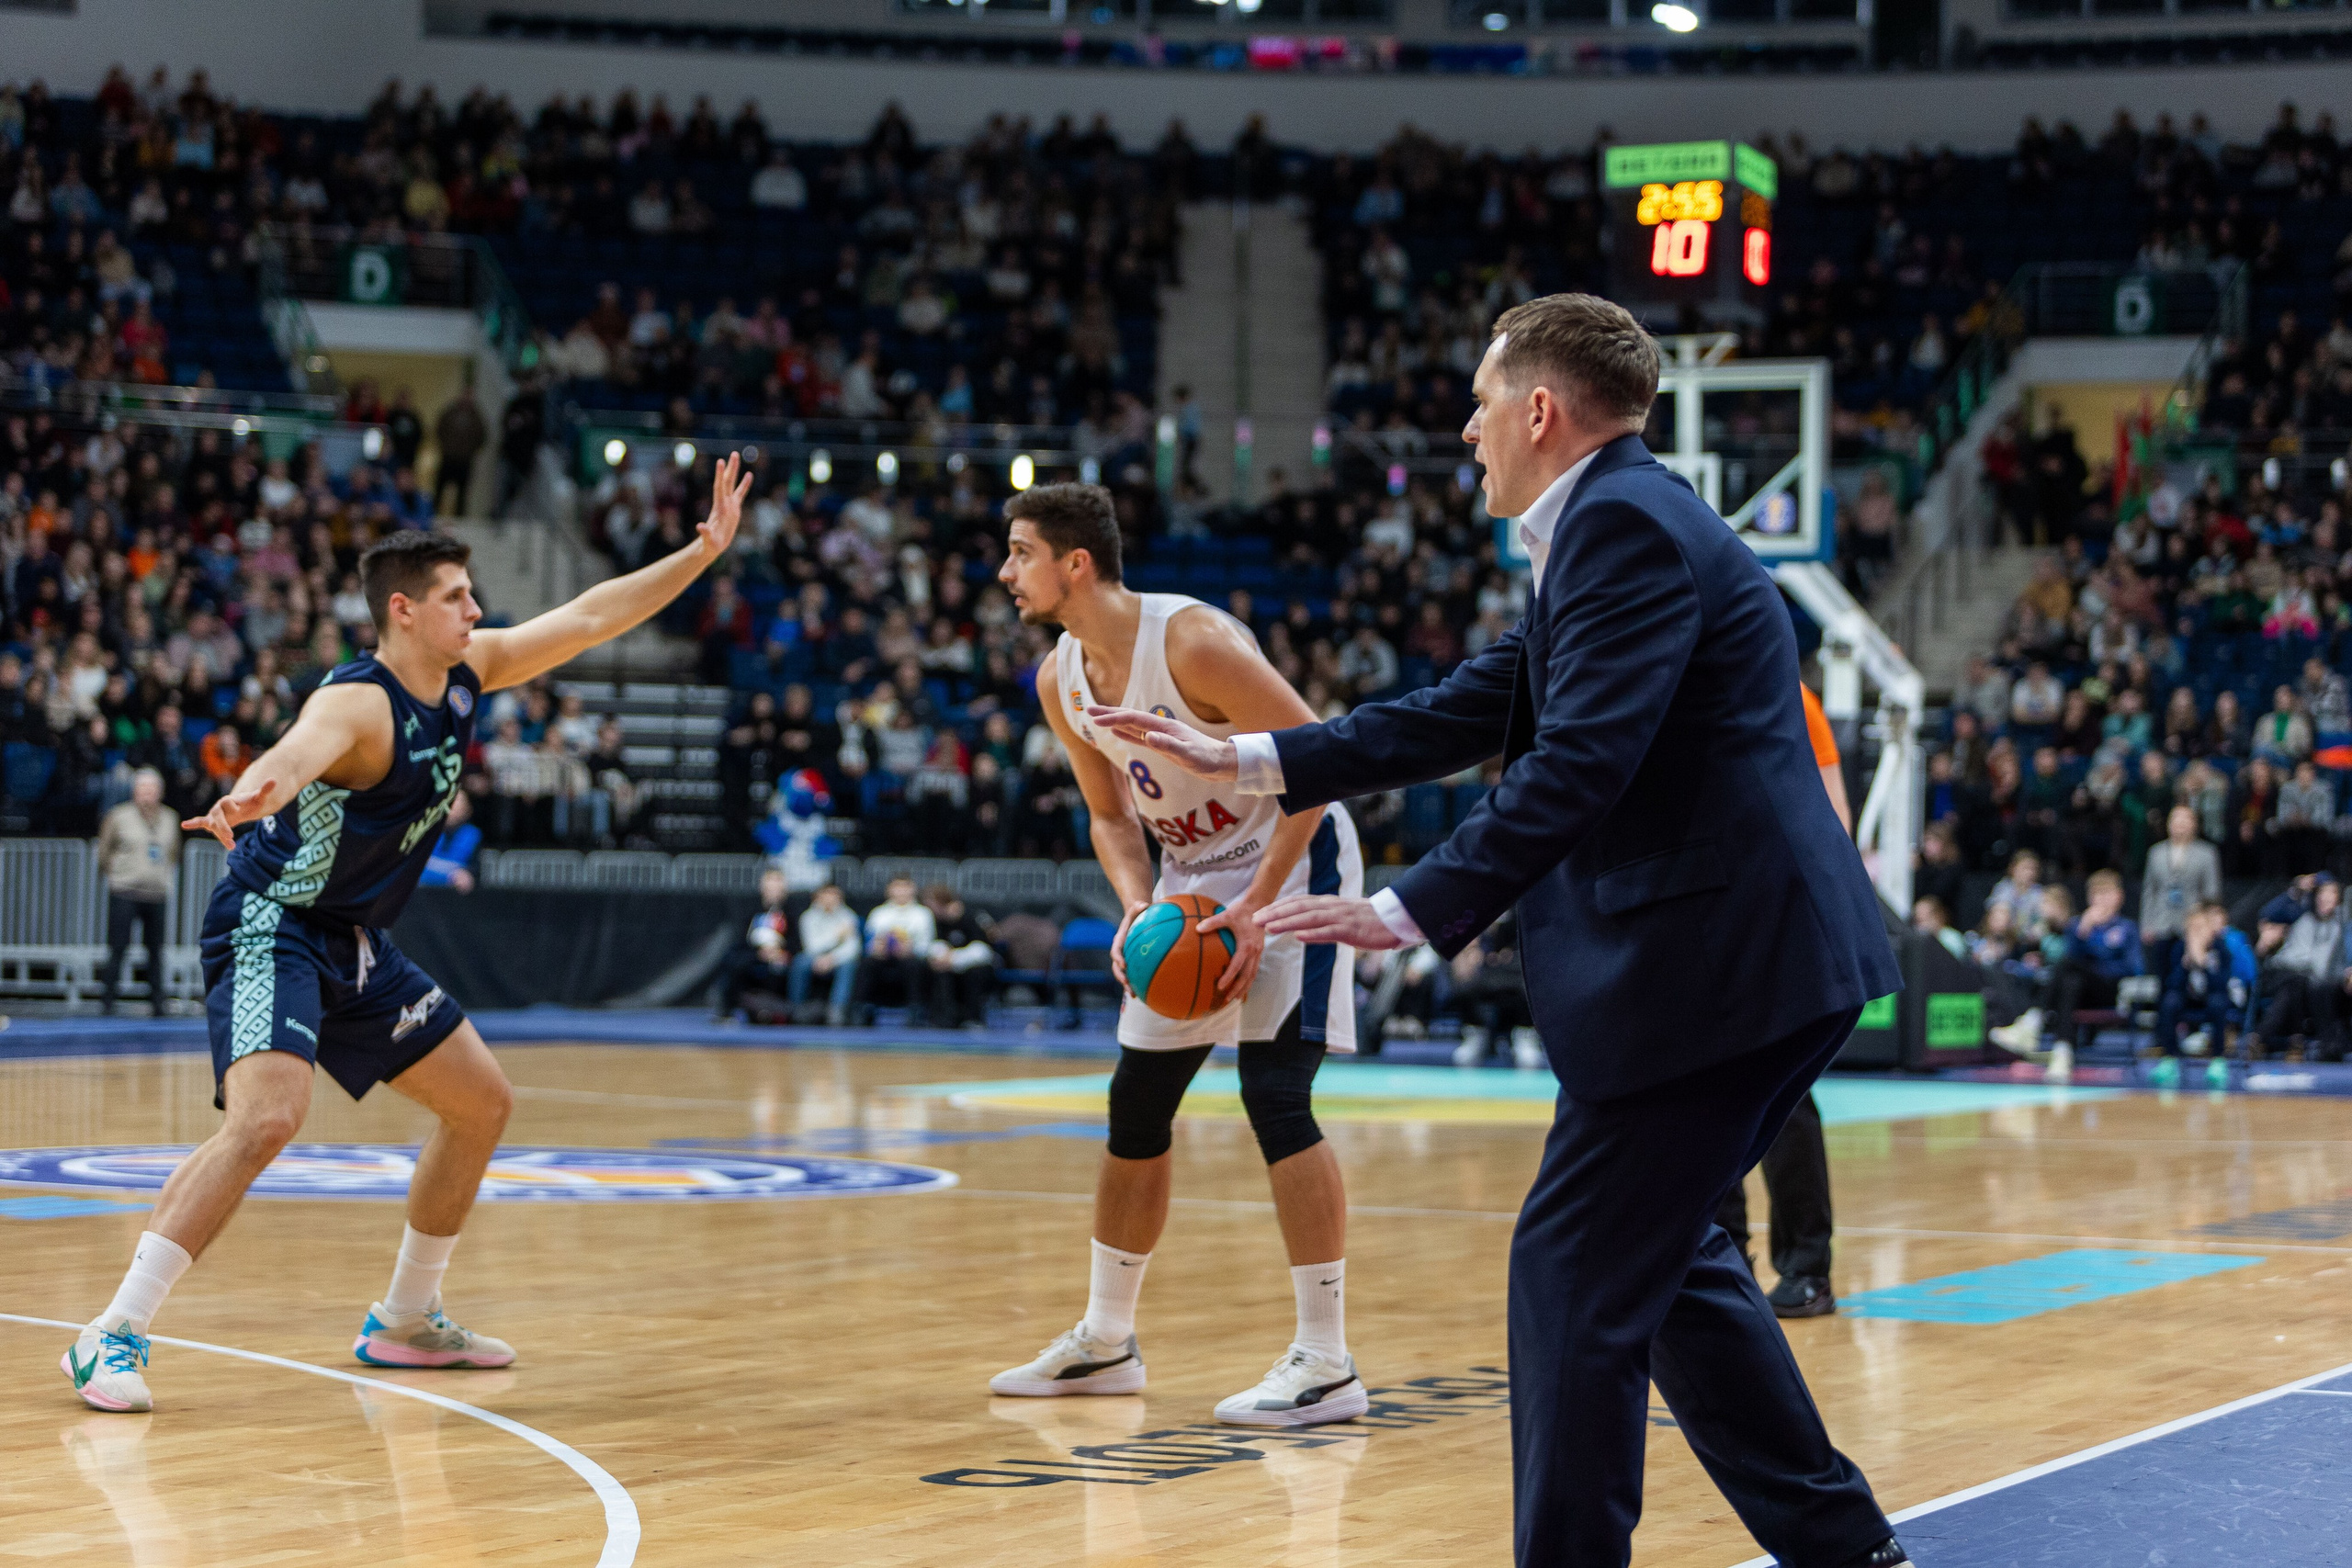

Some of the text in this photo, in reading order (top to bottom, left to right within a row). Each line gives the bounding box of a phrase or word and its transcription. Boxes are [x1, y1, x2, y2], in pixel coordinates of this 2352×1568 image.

[1651, 220, 1711, 276] 10
[352, 251, 390, 299] D
[2115, 284, 2154, 332] D
[1129, 759, 1163, 800] 8
